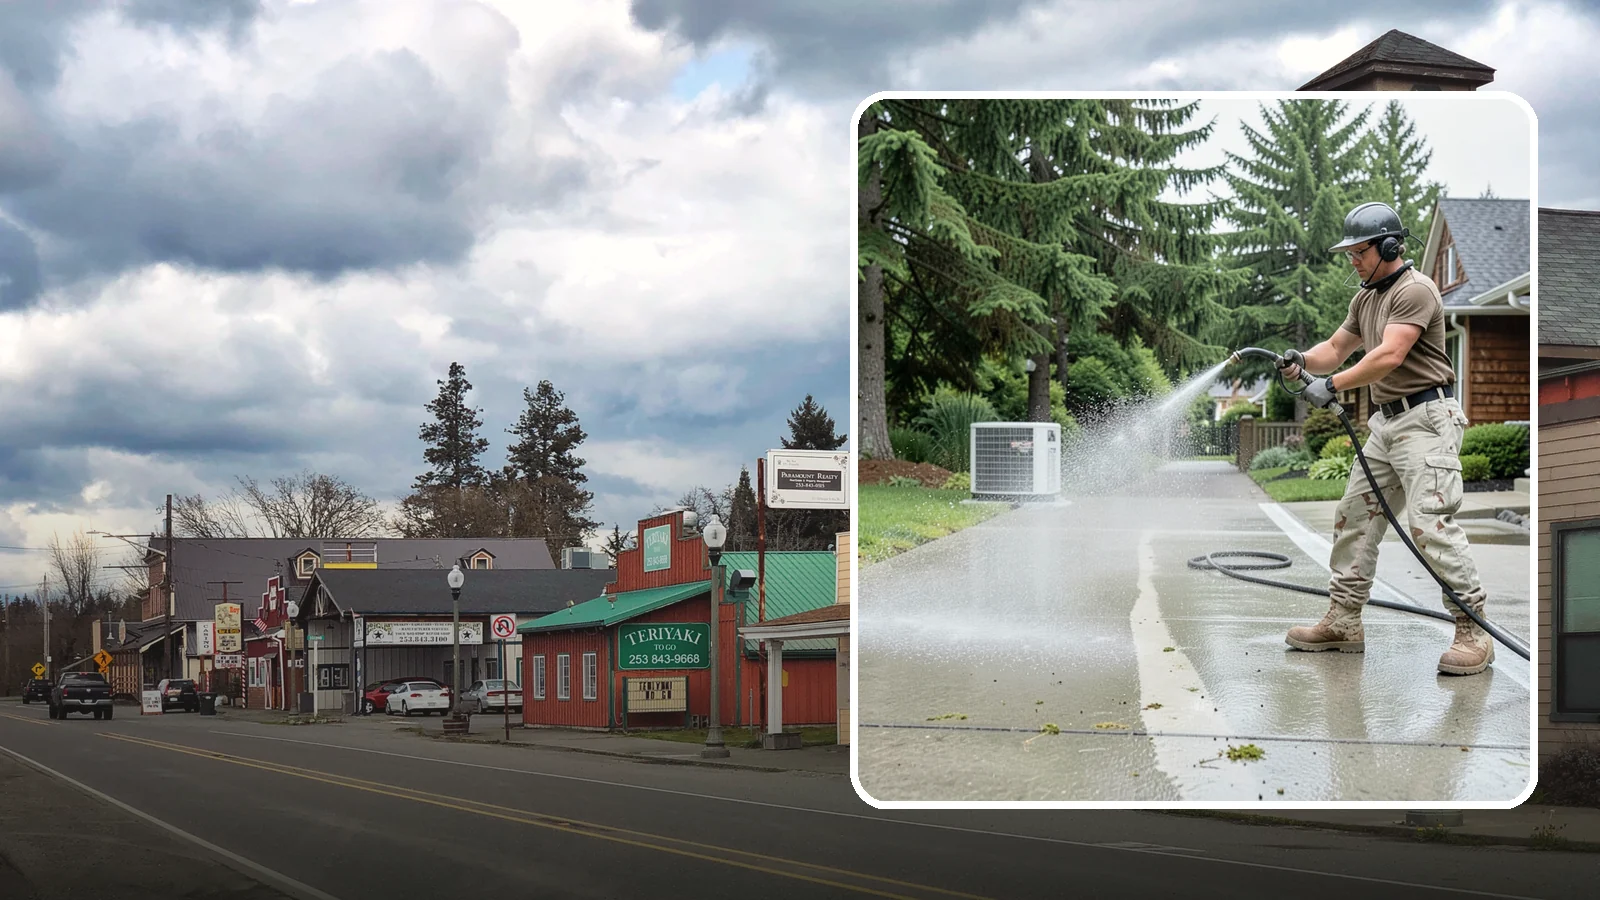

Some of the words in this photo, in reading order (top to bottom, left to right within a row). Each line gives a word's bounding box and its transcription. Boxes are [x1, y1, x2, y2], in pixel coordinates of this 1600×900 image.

[624, 627, 702, 646] TERIYAKI
[628, 654, 649, 665] 253
[651, 653, 700, 664] 843-9668
